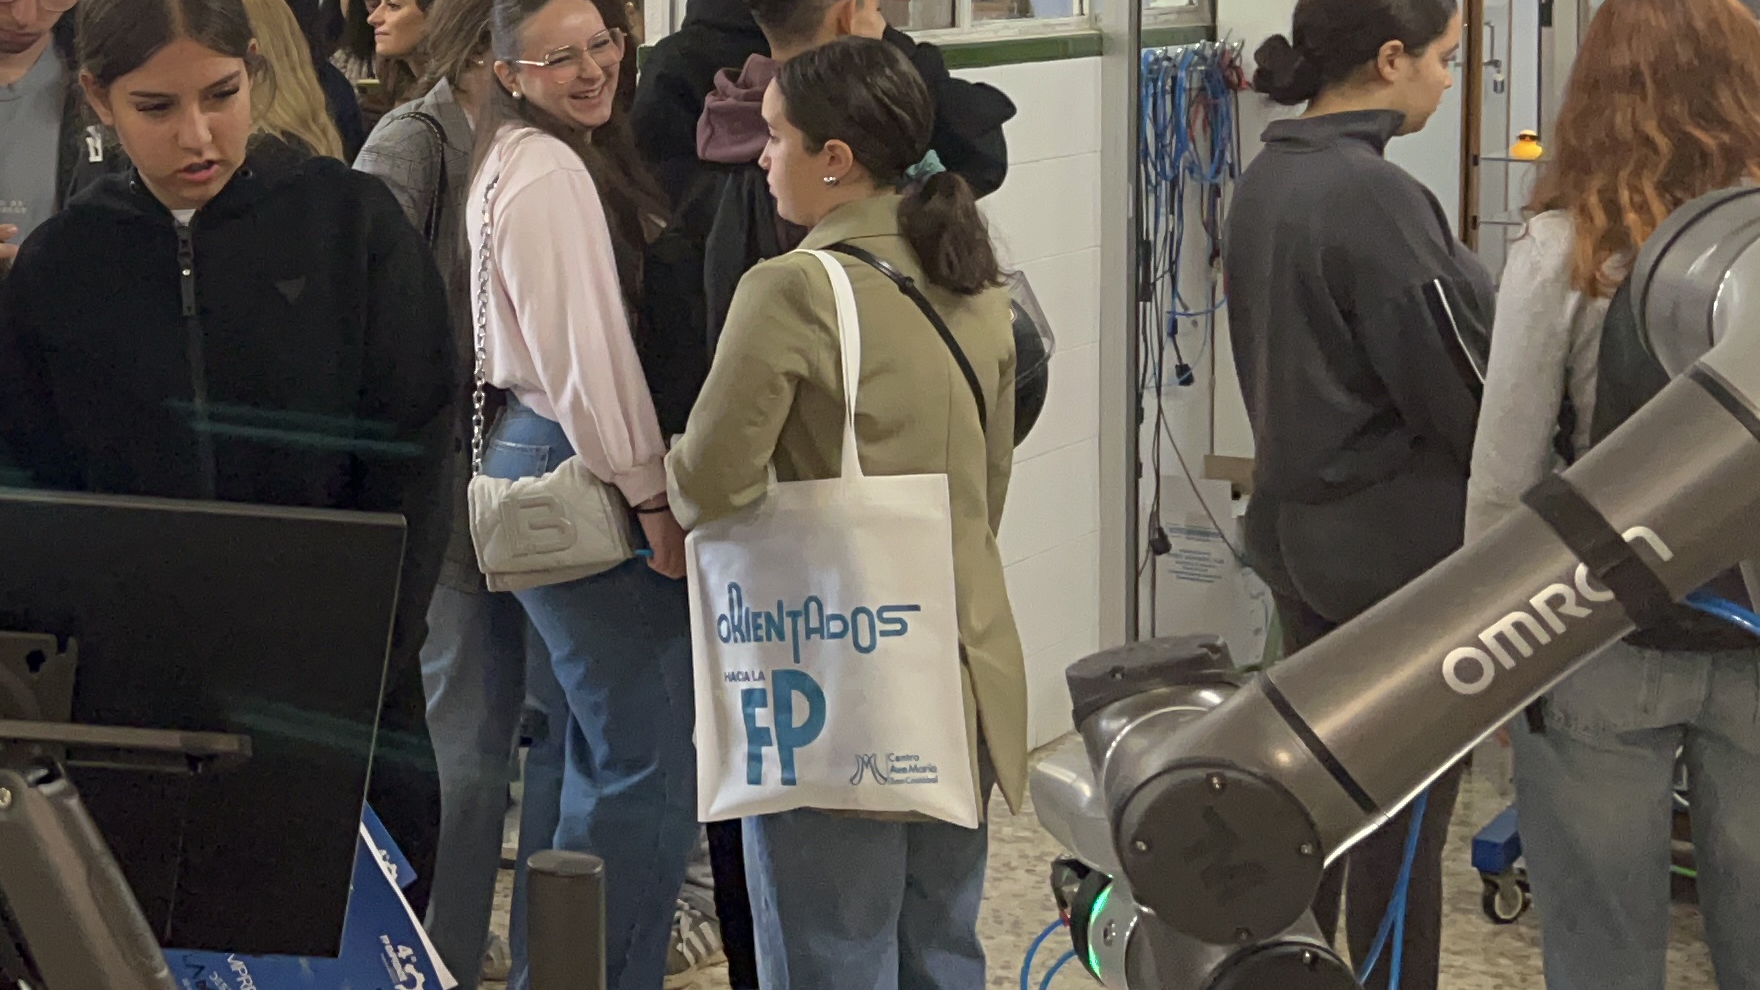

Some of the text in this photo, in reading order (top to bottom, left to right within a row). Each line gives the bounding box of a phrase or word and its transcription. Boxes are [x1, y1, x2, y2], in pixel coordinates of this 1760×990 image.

[717, 581, 922, 664] ORIENTADOS
[751, 670, 766, 682] LA
[740, 669, 827, 787] FP
